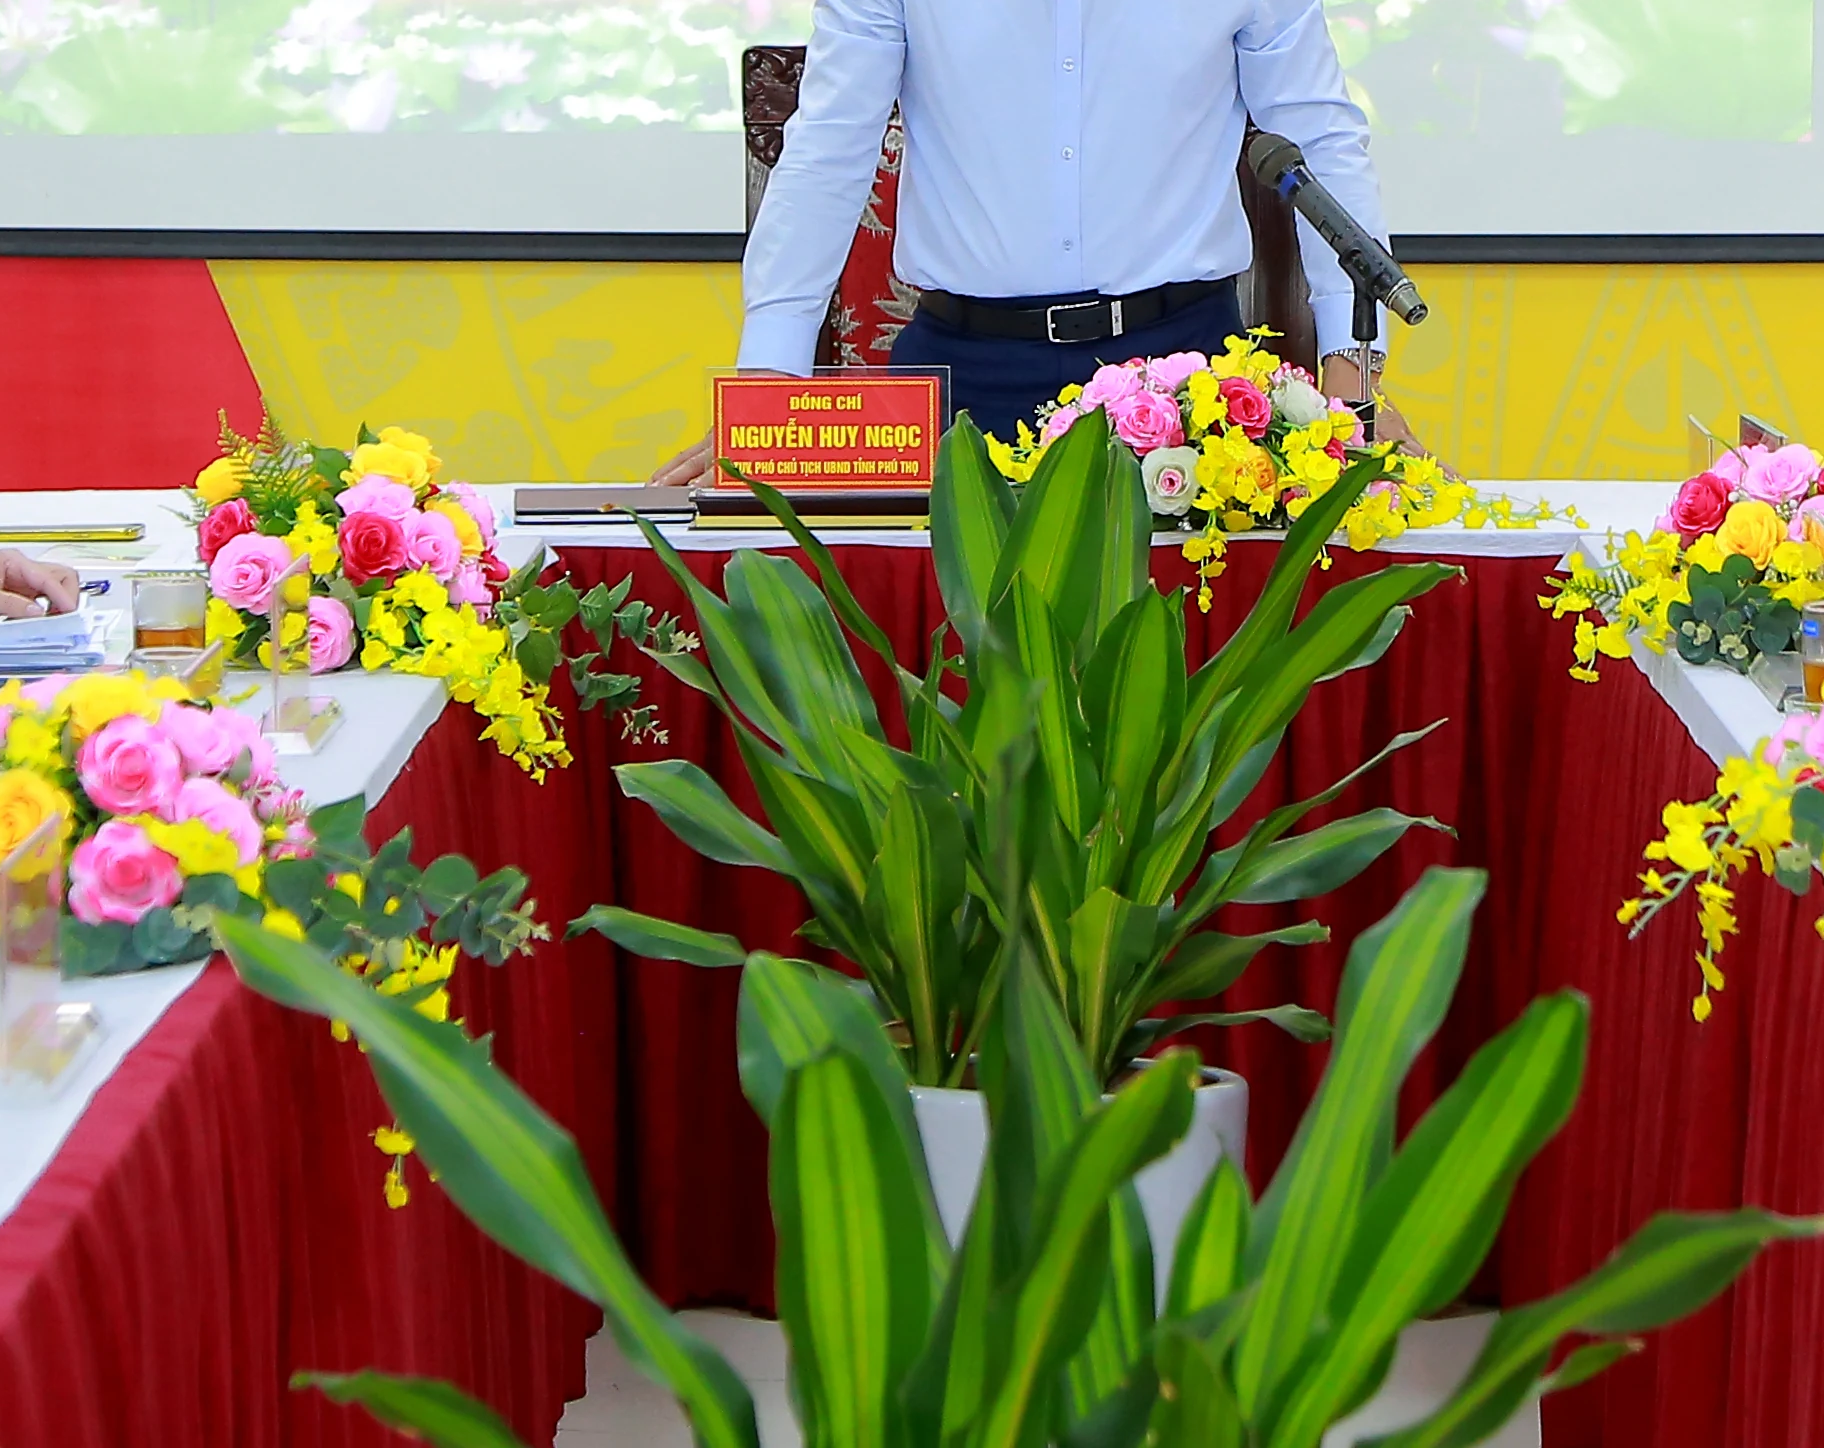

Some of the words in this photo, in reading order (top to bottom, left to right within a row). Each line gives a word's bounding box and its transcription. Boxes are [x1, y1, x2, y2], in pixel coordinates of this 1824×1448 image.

[836, 392, 862, 411] CHÍ
[730, 418, 813, 449] NGUYỄN
[819, 425, 858, 448] HUY
[865, 425, 921, 453] NGỌC
[755, 458, 775, 475] PHÓ
[799, 461, 821, 477] TỊCH
[823, 461, 851, 474] UBND
[878, 458, 898, 474] PHÚ
[900, 461, 919, 477] THỌ
